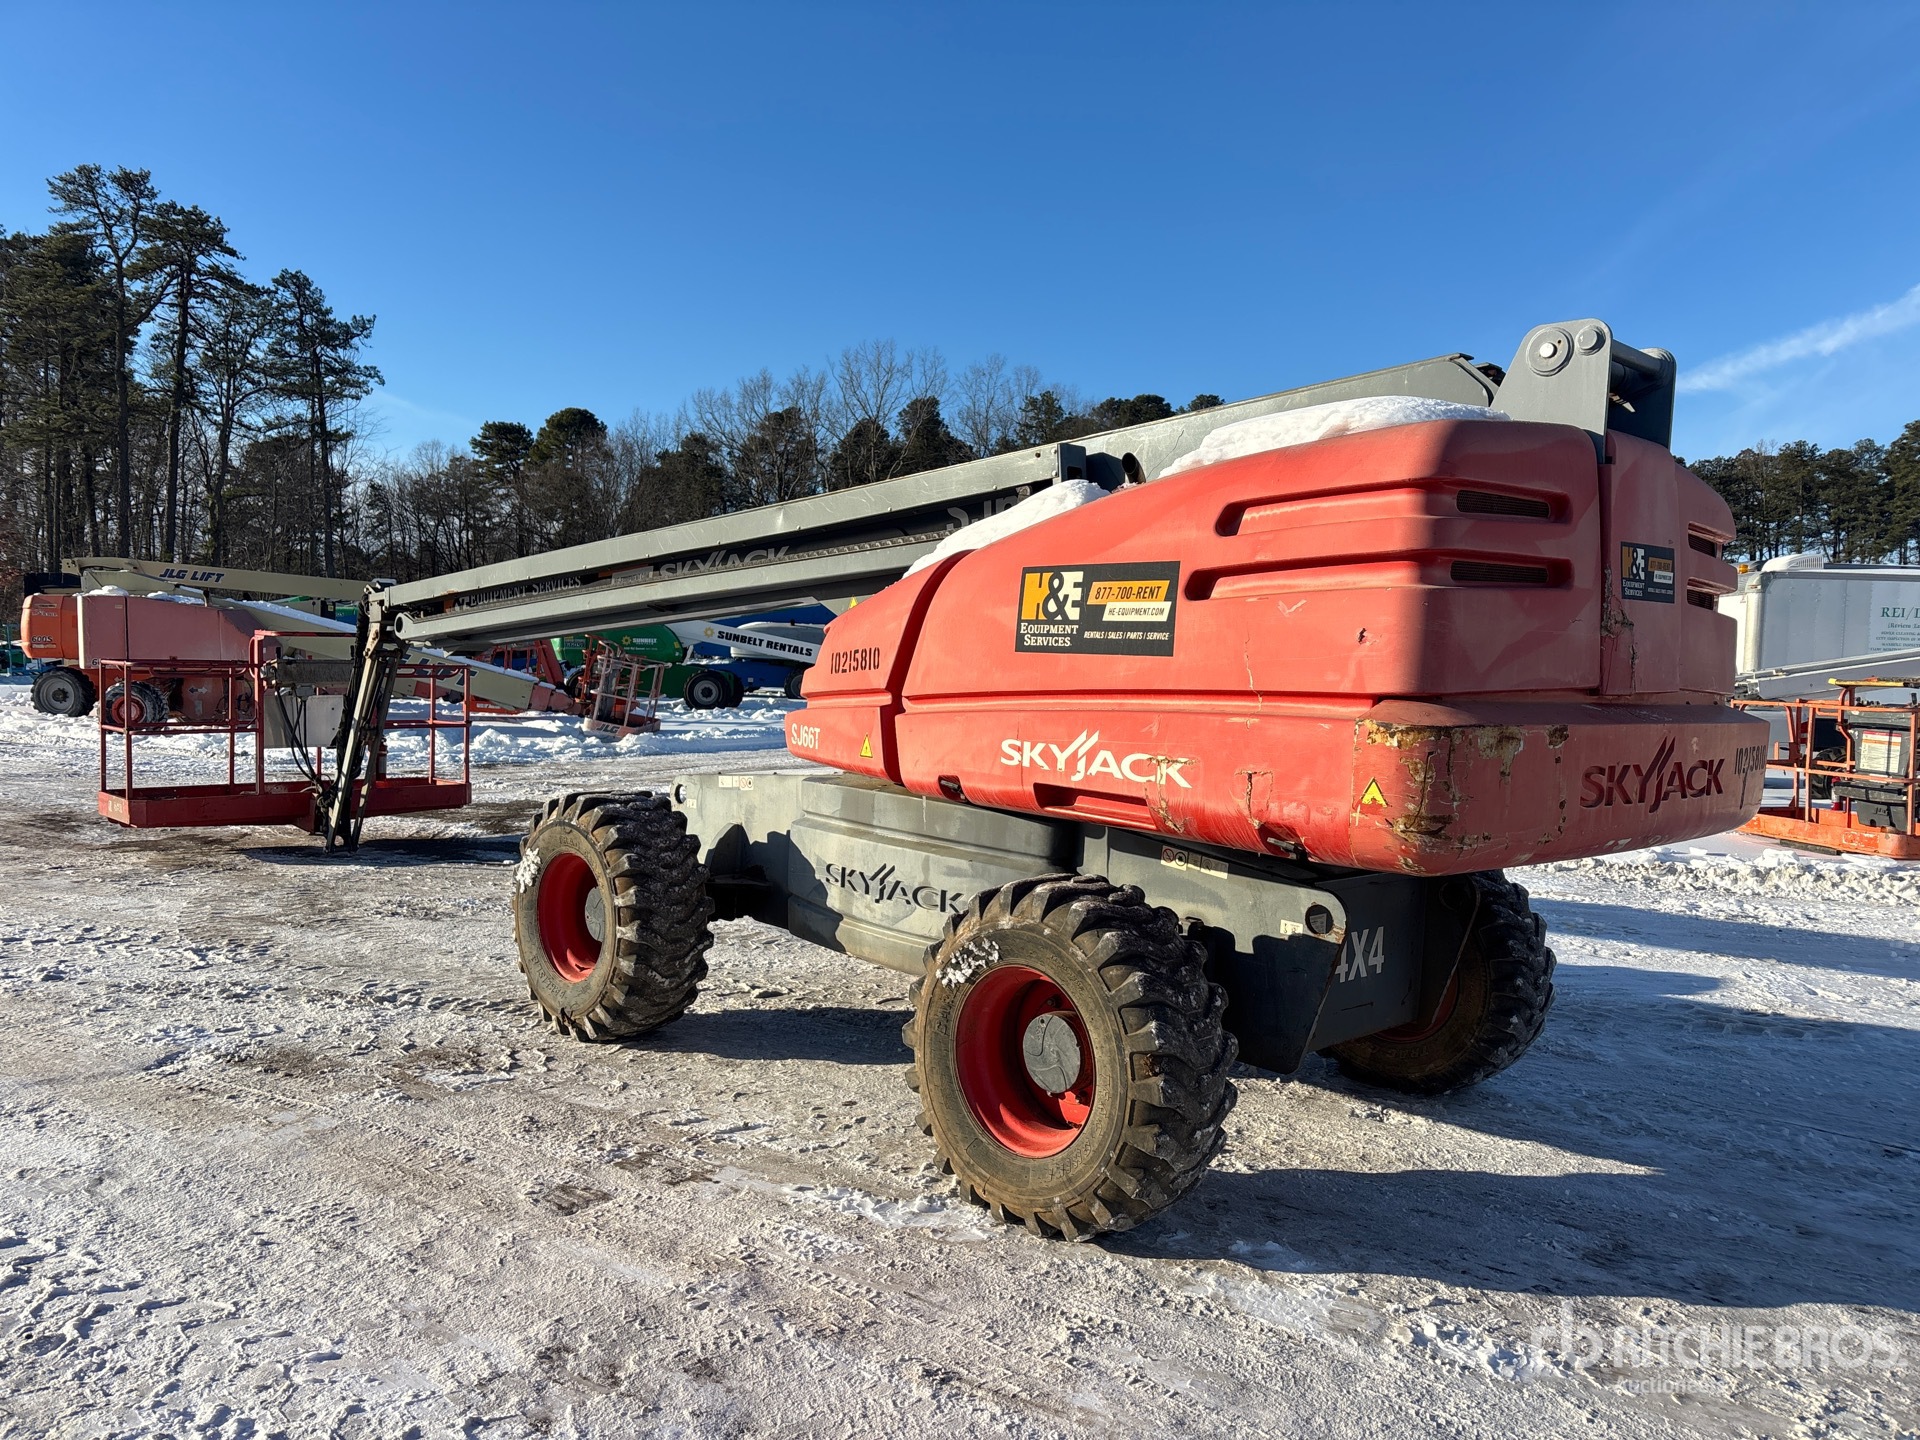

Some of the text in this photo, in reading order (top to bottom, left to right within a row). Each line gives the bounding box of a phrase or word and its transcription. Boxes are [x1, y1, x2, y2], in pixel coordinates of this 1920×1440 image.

[159, 568, 225, 583] JLG LIFT
[1622, 546, 1645, 580] H&E
[470, 584, 528, 607] EQUIPMENT
[532, 575, 582, 596] SERVICES
[1021, 571, 1083, 620] H&E
[1095, 586, 1162, 600] 877-700-RENT
[1108, 607, 1165, 616] HE-EQUIPMENT.COM
[31, 635, 53, 643] 600S
[1020, 622, 1079, 635] EQUIPMENT
[1023, 634, 1072, 647] SERVICES
[1084, 631, 1169, 640] RENTALS SALES PARTS SERVICE
[717, 630, 813, 657] SUNBELT RENTALS
[831, 647, 880, 675] 10215810
[596, 723, 620, 734] JLG
[791, 723, 821, 750] SJ66T
[1001, 728, 1193, 789] SKYJACK
[1580, 736, 1725, 813] SKYJACK
[825, 862, 965, 913] SKYJACK
[1335, 926, 1385, 983] 4X4
